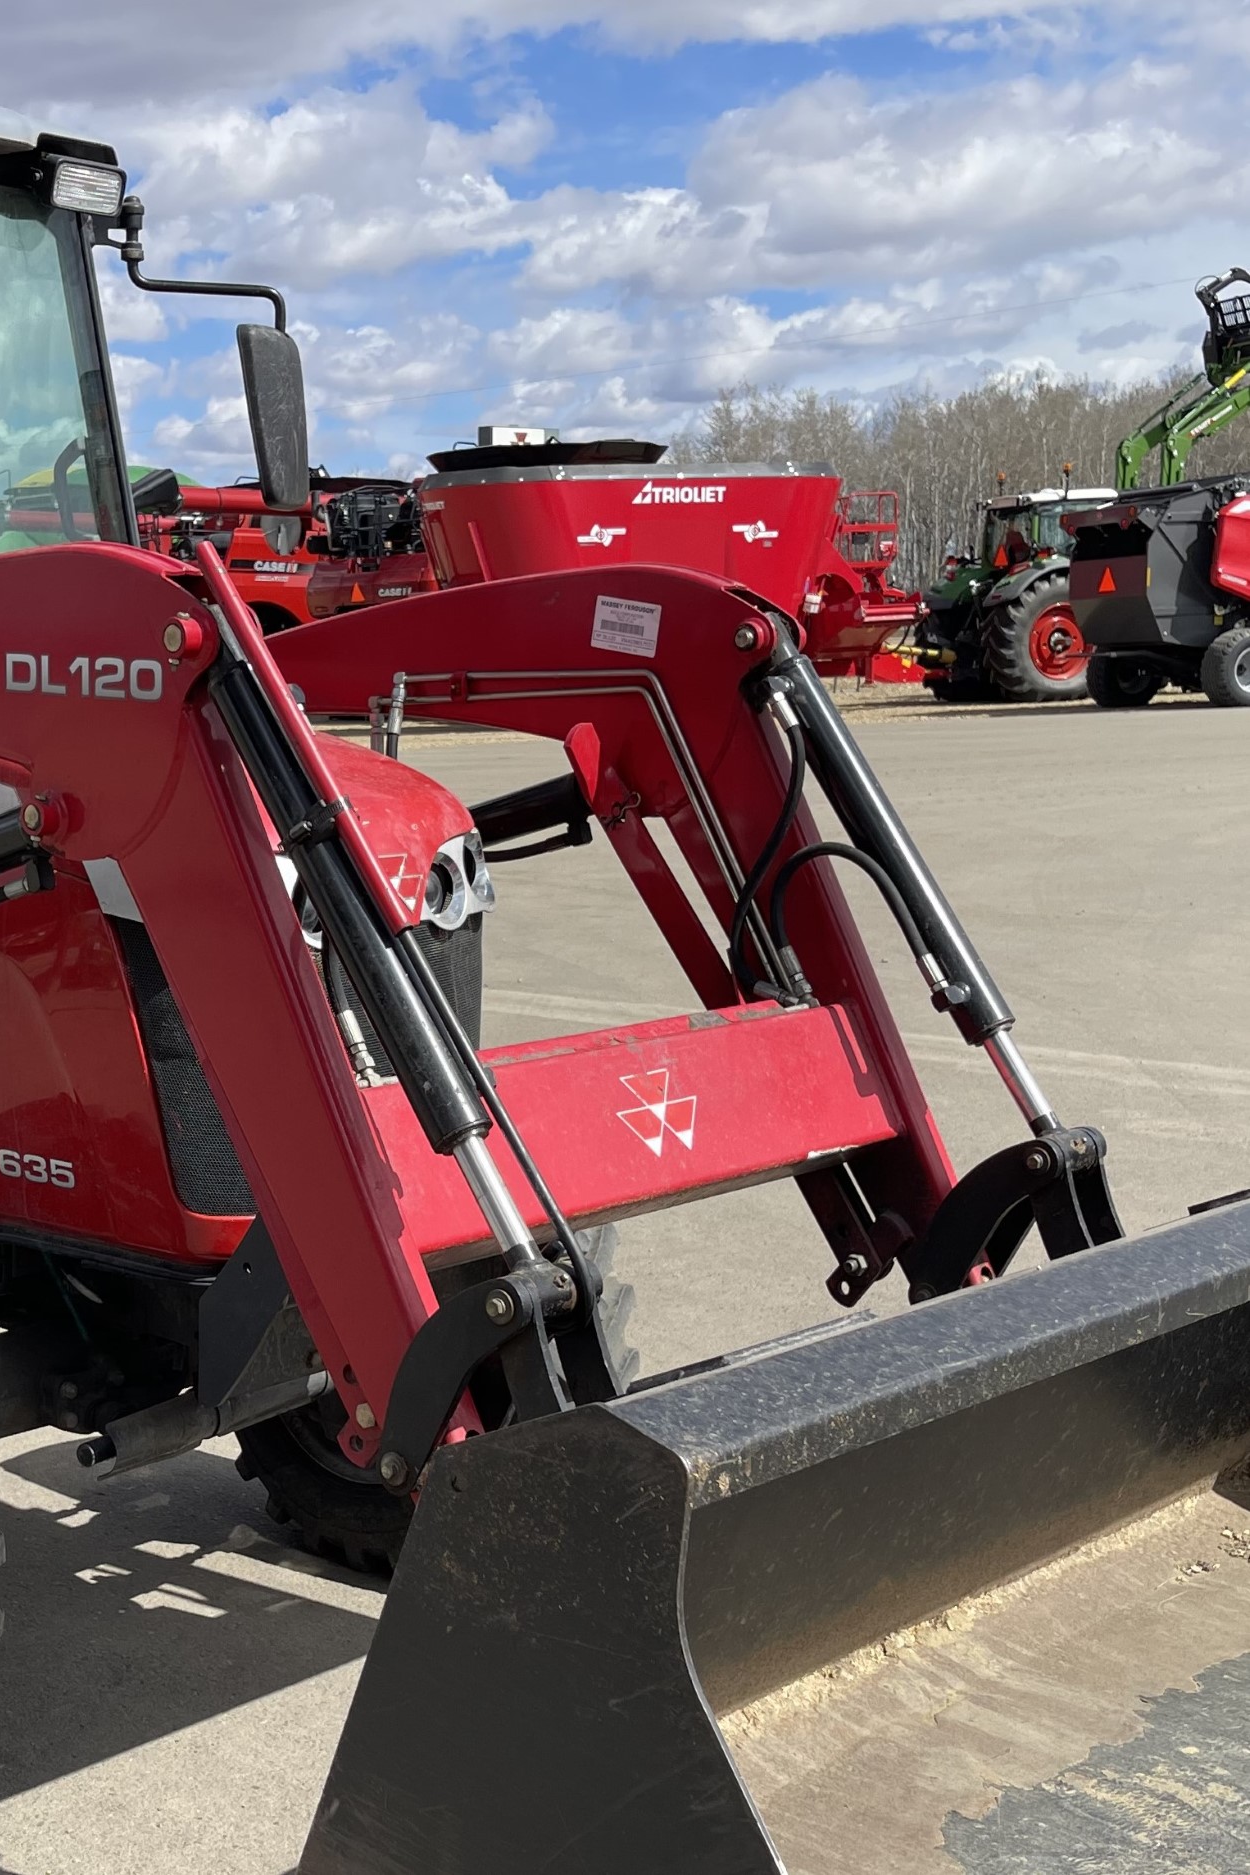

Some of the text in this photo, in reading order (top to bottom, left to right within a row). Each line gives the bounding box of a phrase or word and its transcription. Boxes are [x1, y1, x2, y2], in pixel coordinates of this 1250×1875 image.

[651, 486, 726, 504] TRIOLIET
[253, 561, 286, 572] CASE
[378, 588, 402, 597] CASE
[6, 653, 162, 700] DL120
